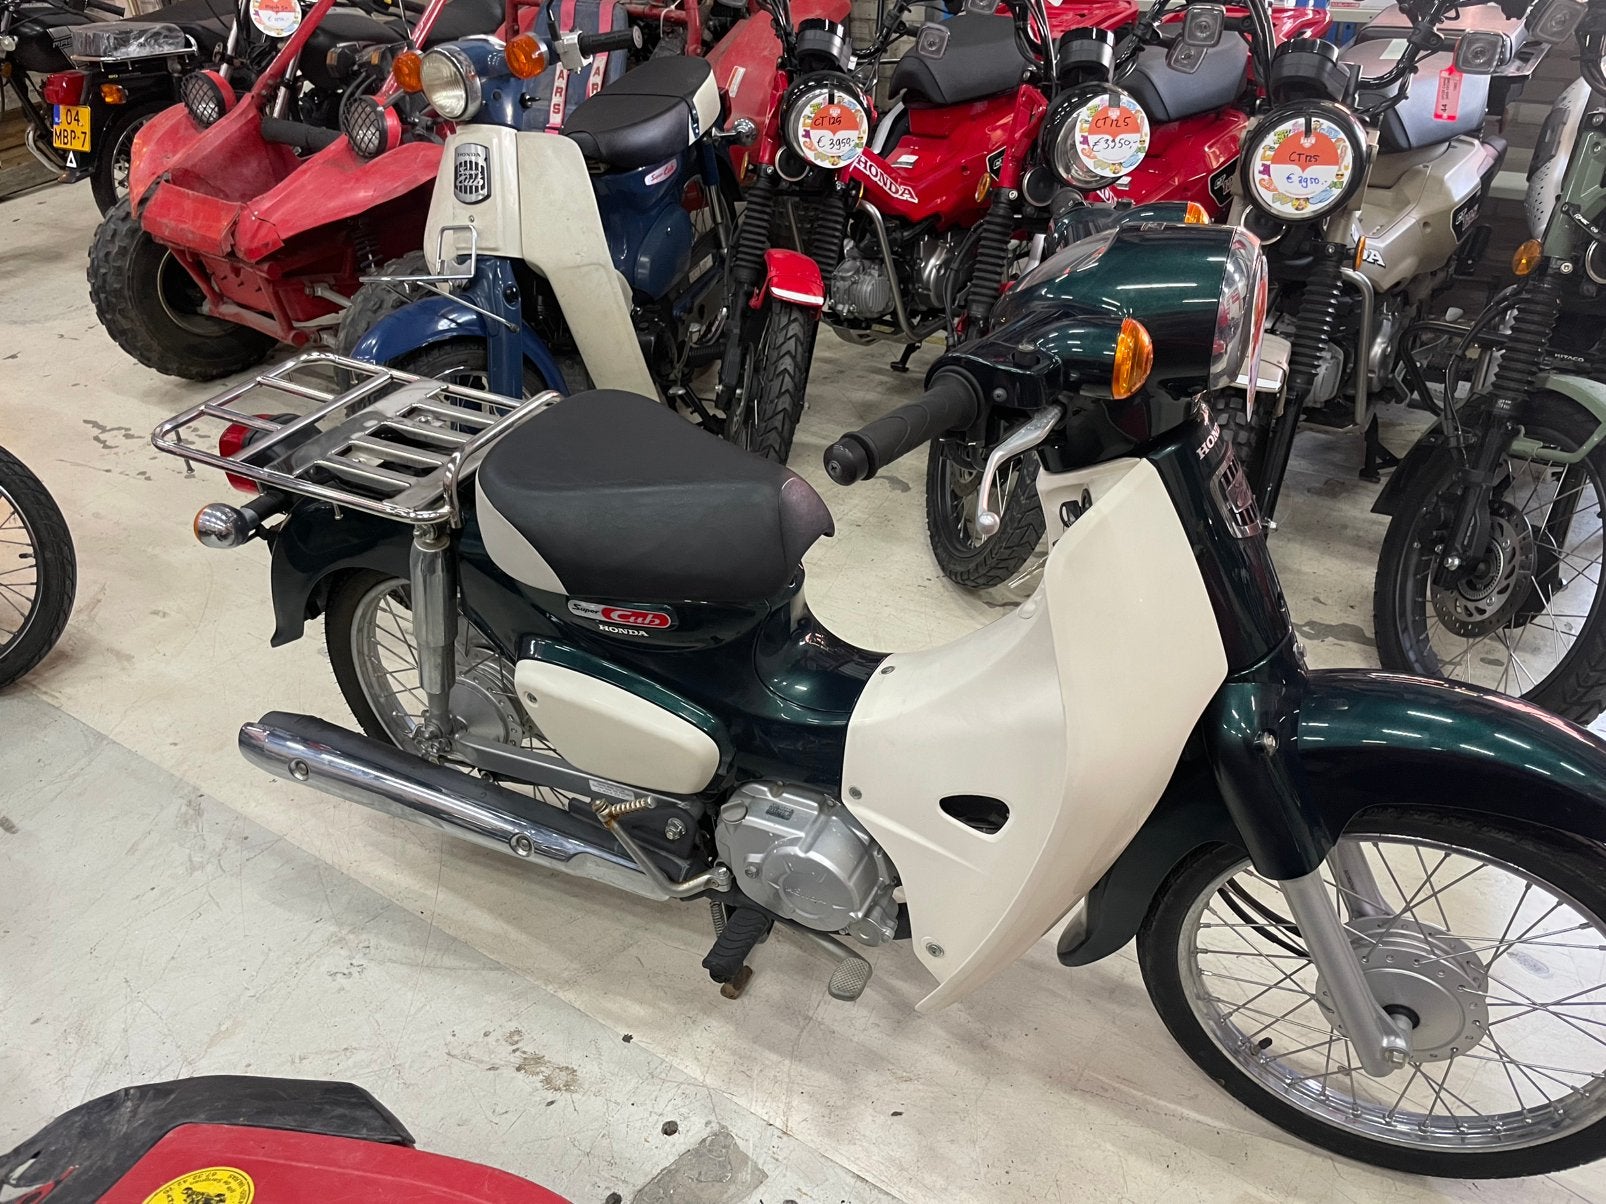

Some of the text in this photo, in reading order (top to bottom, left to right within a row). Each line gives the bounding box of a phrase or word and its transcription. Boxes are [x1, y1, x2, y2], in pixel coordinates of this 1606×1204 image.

[65, 108, 81, 126] 04
[849, 154, 919, 204] HONDA
[571, 603, 661, 626] Super Cub
[598, 624, 650, 637] HONDA
